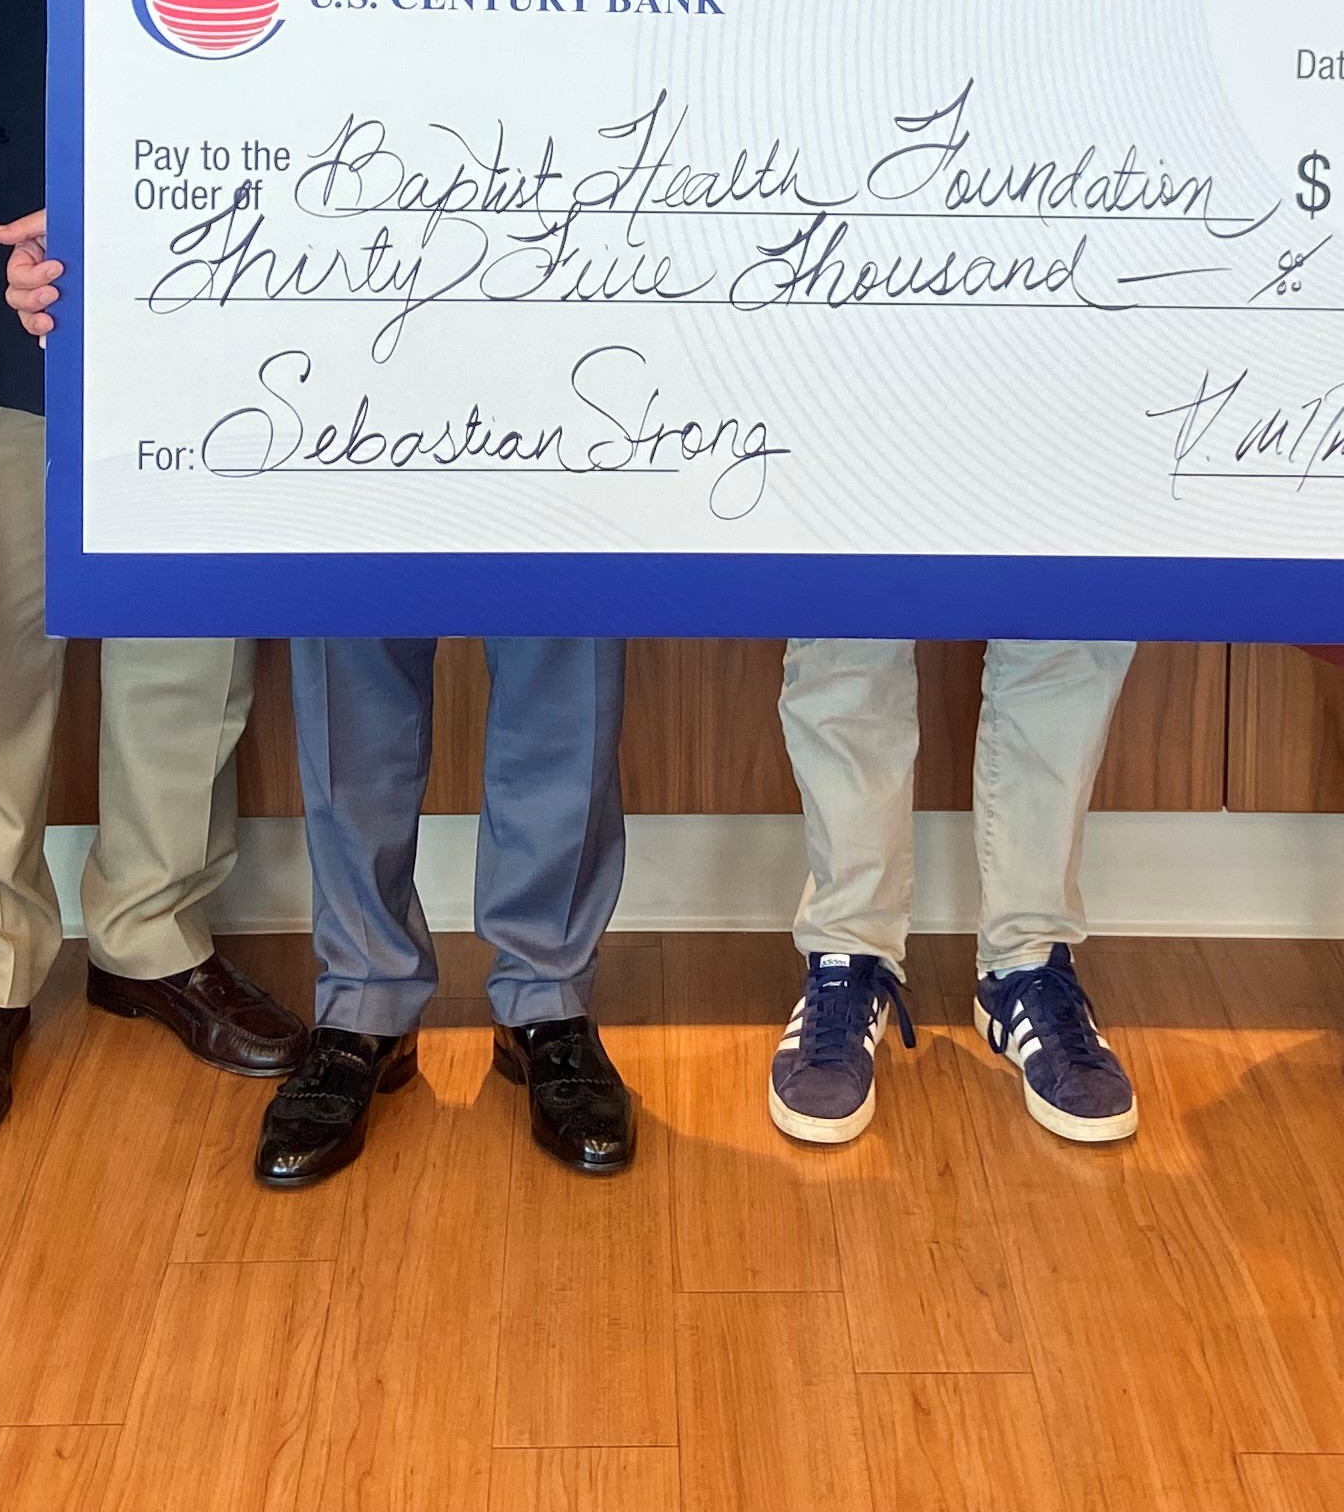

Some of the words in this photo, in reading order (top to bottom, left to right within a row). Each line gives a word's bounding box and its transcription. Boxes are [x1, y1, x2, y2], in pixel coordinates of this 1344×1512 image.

[135, 139, 189, 178] Pay
[200, 141, 230, 171] to
[243, 139, 291, 172] the
[294, 112, 563, 245] Baptist
[575, 88, 856, 245] Health
[867, 77, 1283, 238] Foundation
[1296, 149, 1332, 219] $
[135, 179, 223, 211] Order
[233, 179, 263, 212] of
[149, 181, 489, 364] Thirty
[729, 211, 1138, 310] Thousand
[138, 441, 195, 471] For:
[201, 349, 588, 477] Sebastian
[571, 346, 790, 520] Strong
